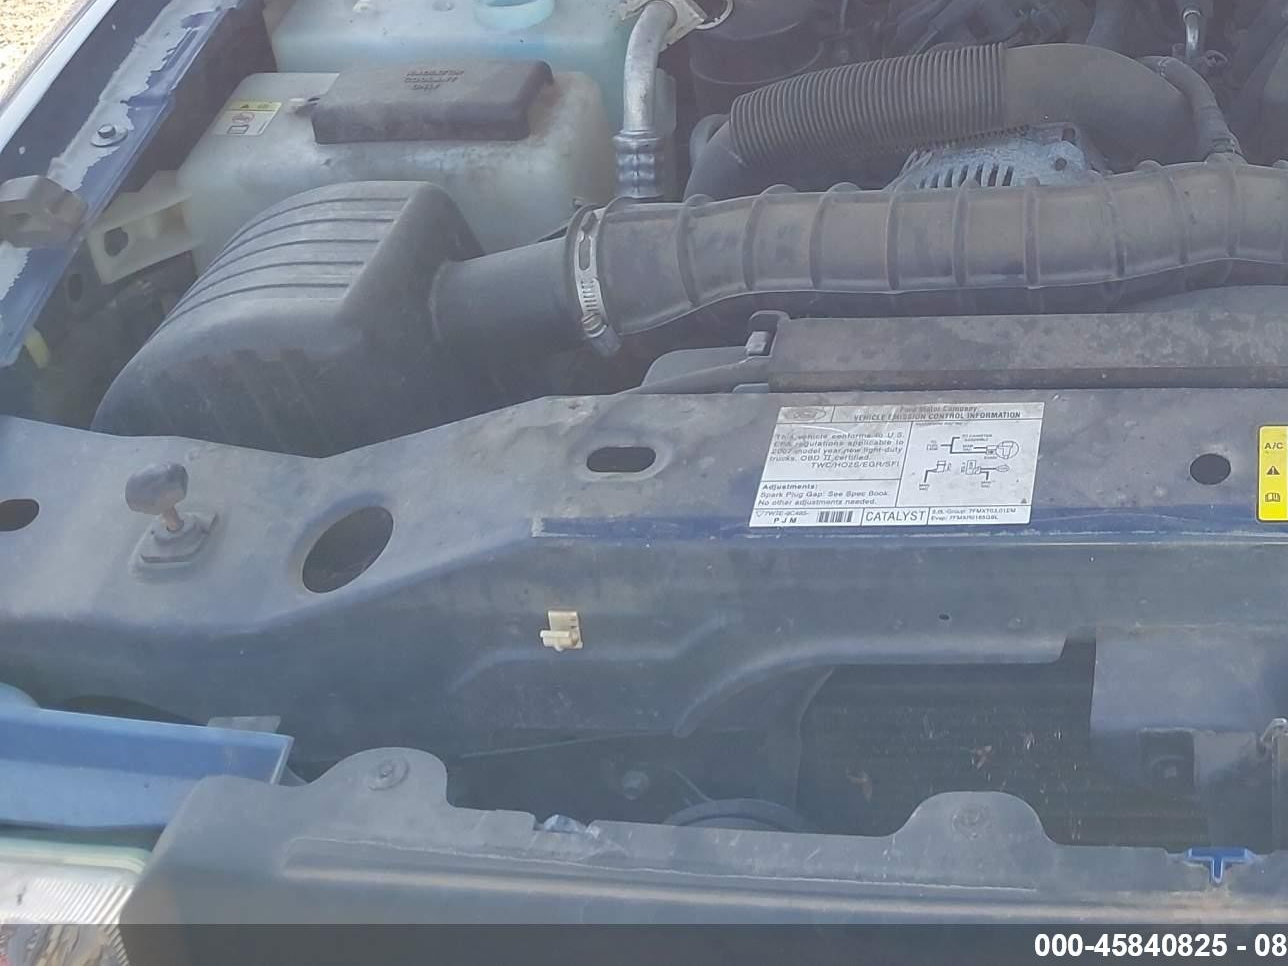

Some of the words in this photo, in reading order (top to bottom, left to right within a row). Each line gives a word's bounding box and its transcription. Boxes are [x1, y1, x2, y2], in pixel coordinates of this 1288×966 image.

[942, 406, 978, 414] Company
[1264, 442, 1284, 450] A/C
[865, 510, 926, 522] CATALYST
